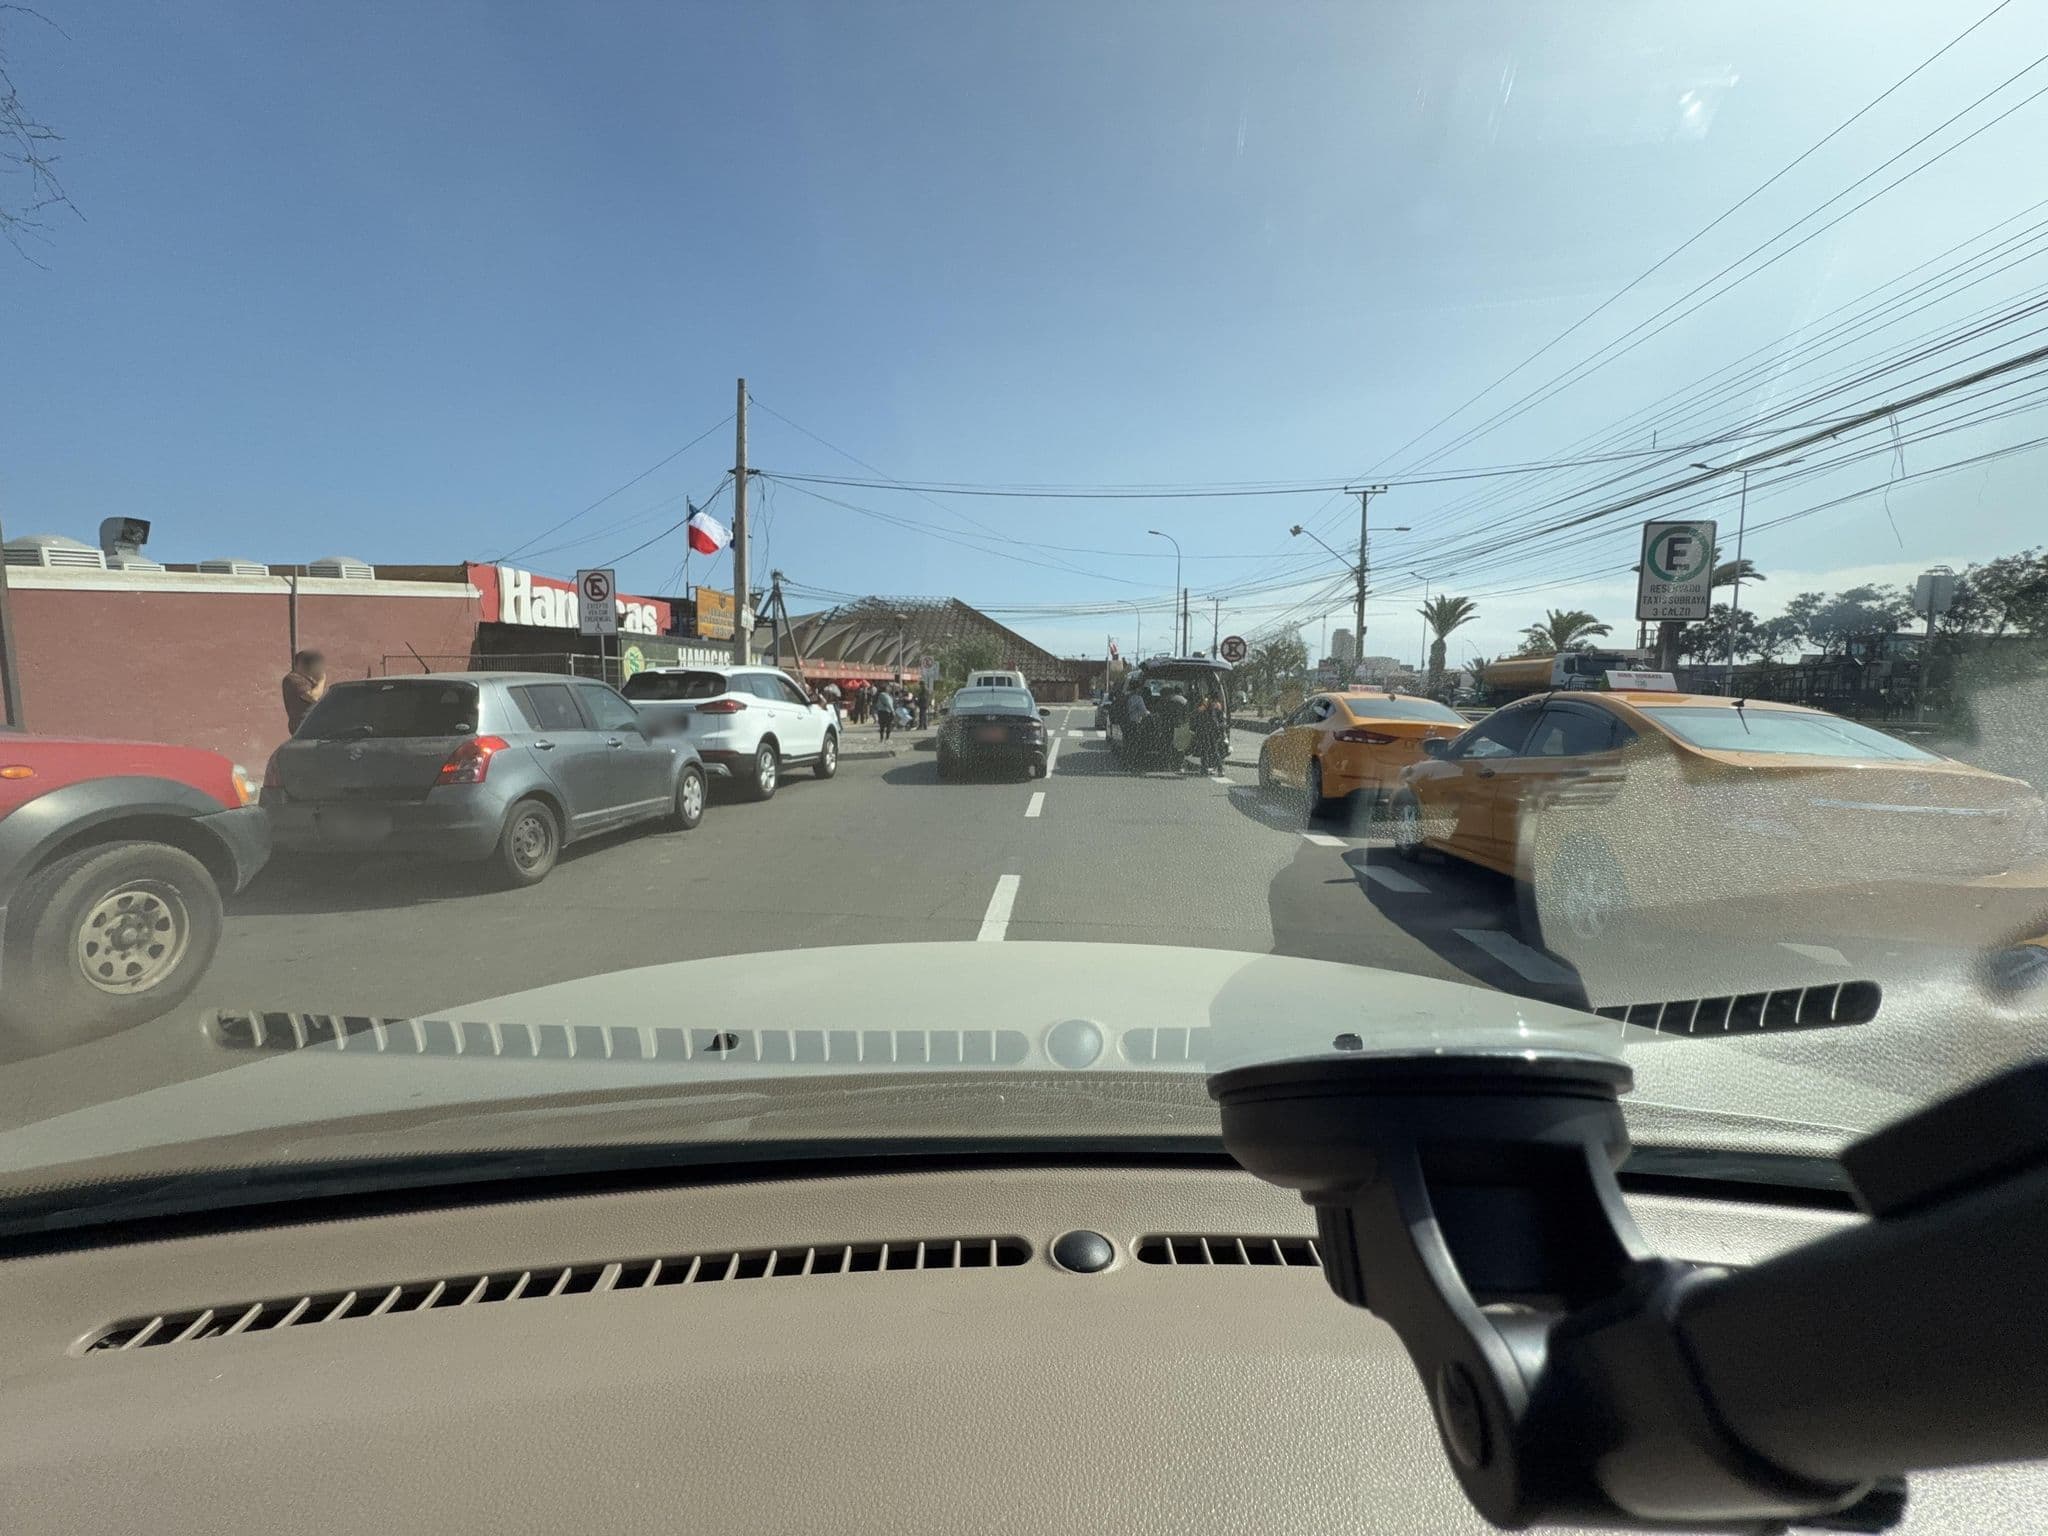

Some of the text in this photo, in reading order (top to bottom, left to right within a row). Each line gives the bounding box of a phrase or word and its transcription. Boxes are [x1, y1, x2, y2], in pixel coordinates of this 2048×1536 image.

[1665, 536, 1693, 571] E
[1652, 607, 1658, 617] 3
[678, 647, 731, 668] HAMACAS
